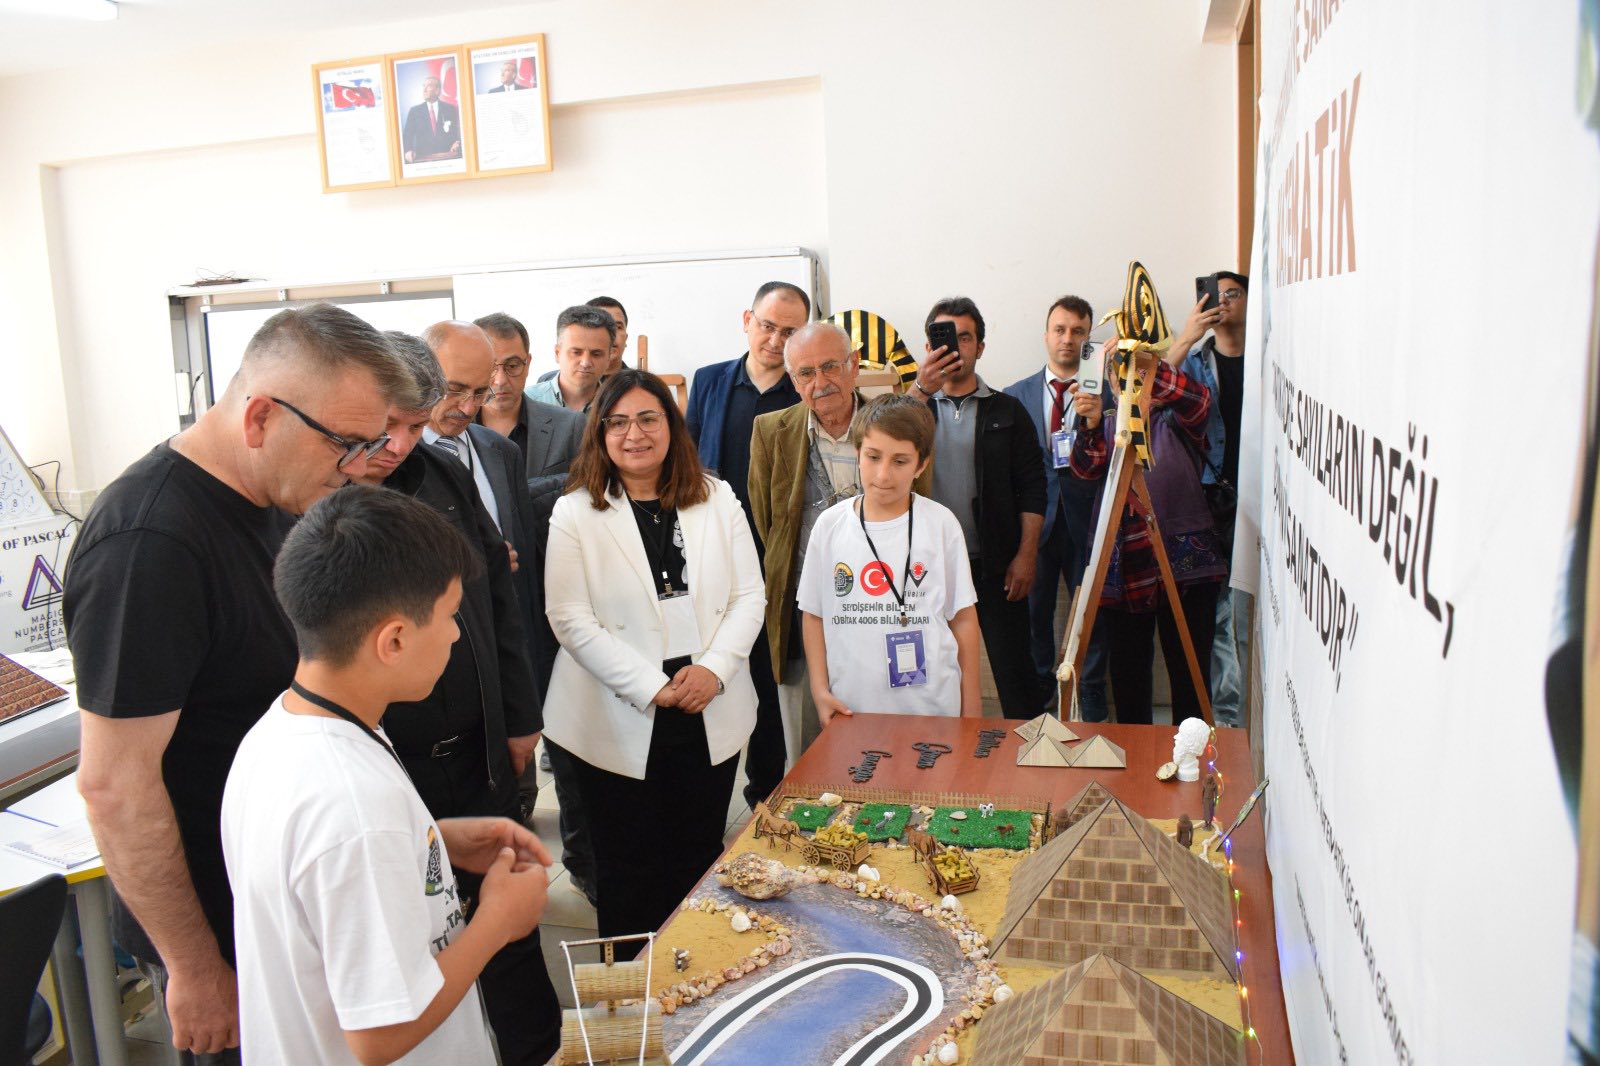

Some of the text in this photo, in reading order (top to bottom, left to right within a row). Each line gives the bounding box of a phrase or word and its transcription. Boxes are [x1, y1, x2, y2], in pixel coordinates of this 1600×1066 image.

[1297, 389, 1455, 660] SAYILARIN DEĞİL,
[2, 529, 70, 551] OF PASCAL
[842, 602, 916, 613] SEYDİŞEHİR BİLEM
[31, 608, 64, 624] MAGIC
[832, 614, 857, 625] TÜBİTAK
[858, 616, 878, 625] 4006
[14, 617, 64, 639] NUMBERS
[30, 628, 64, 643] PASCA
